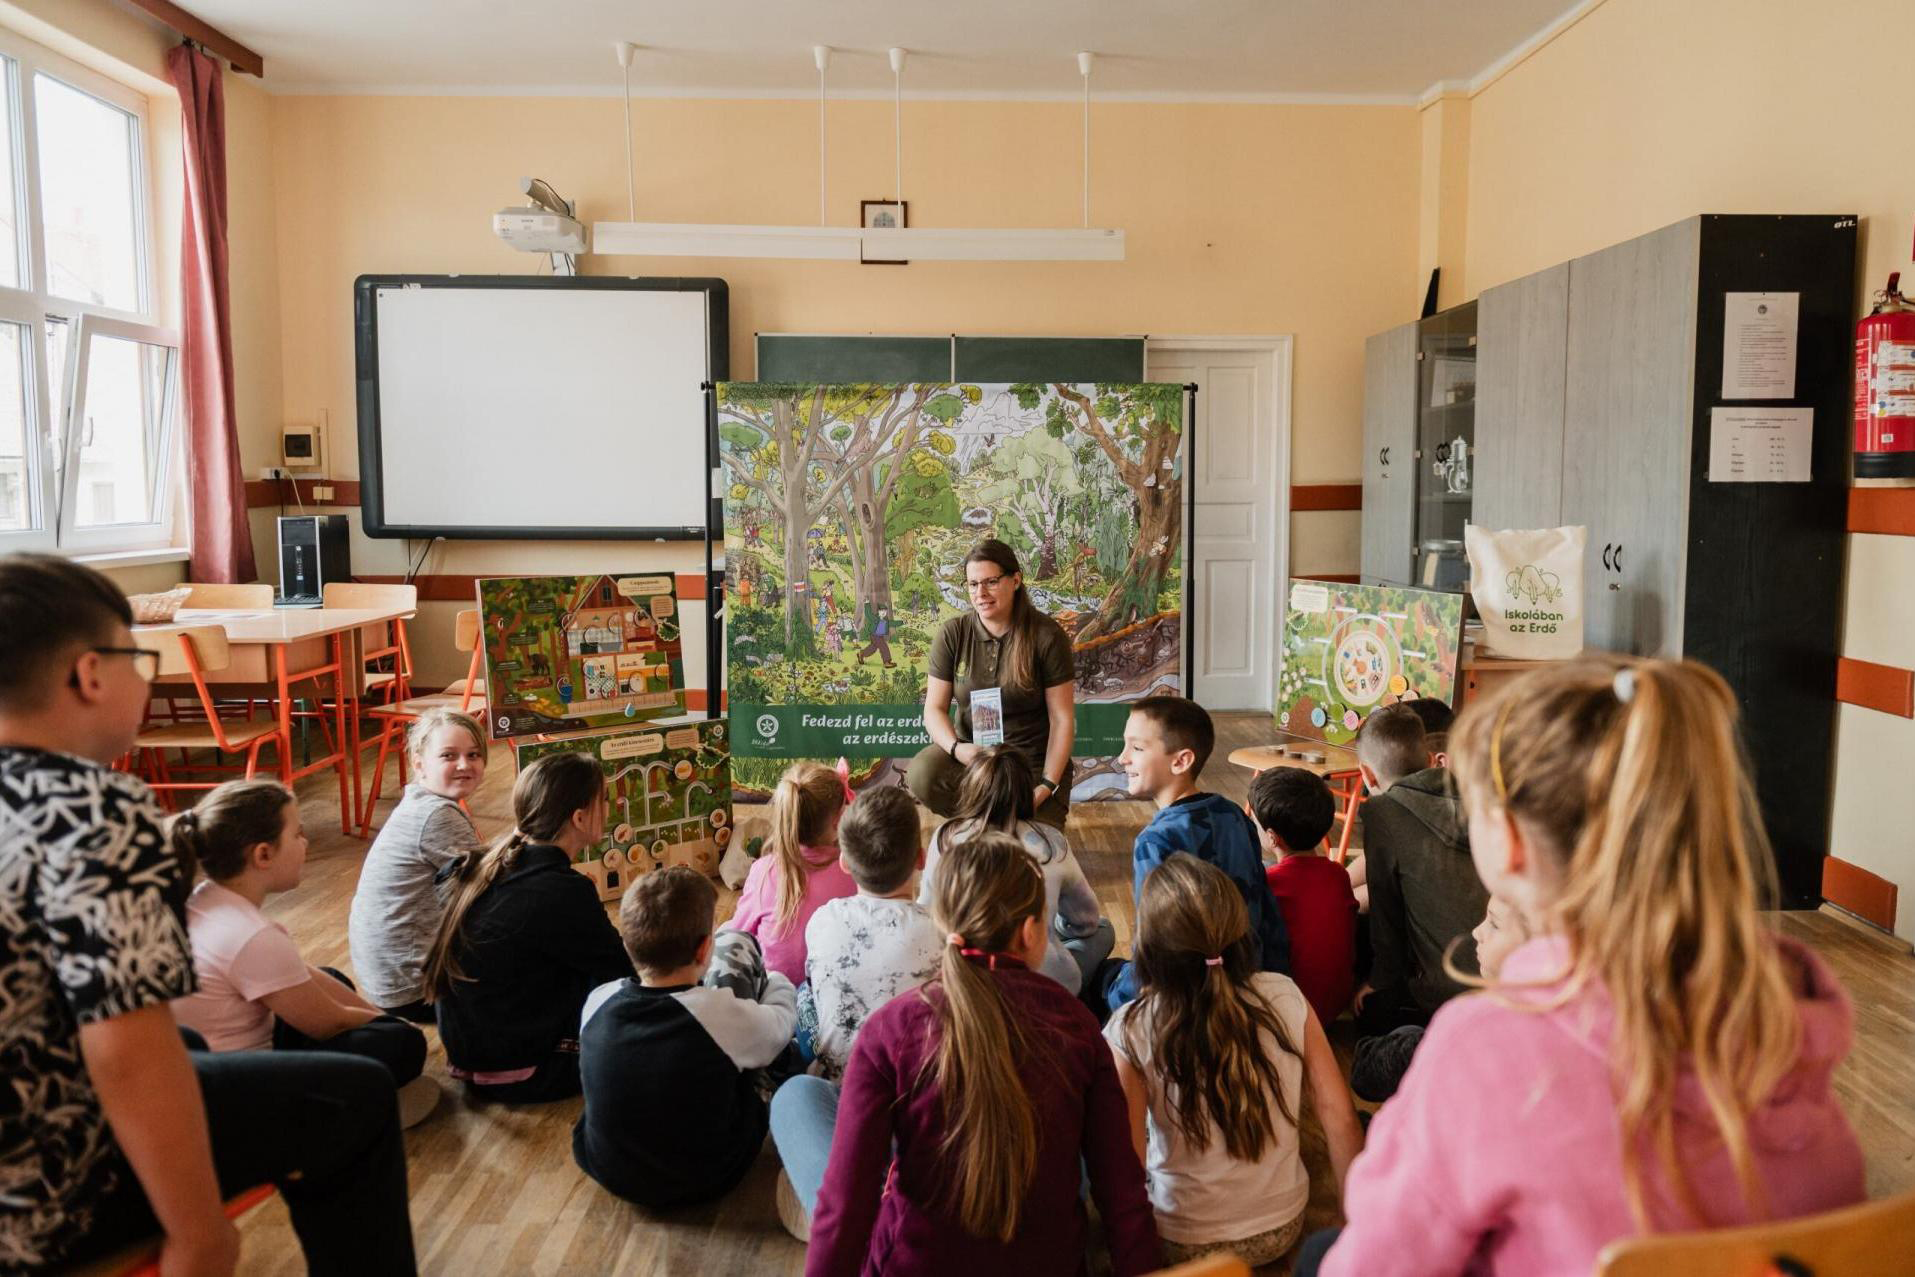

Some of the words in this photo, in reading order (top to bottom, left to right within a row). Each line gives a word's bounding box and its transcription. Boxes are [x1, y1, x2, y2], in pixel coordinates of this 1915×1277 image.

[1504, 609, 1564, 621] Iskolában
[1509, 625, 1526, 633] az
[1529, 623, 1557, 634] Erdő
[802, 715, 851, 728] Fedezd
[855, 715, 873, 730] fel
[876, 717, 894, 727] az
[842, 735, 860, 745] az
